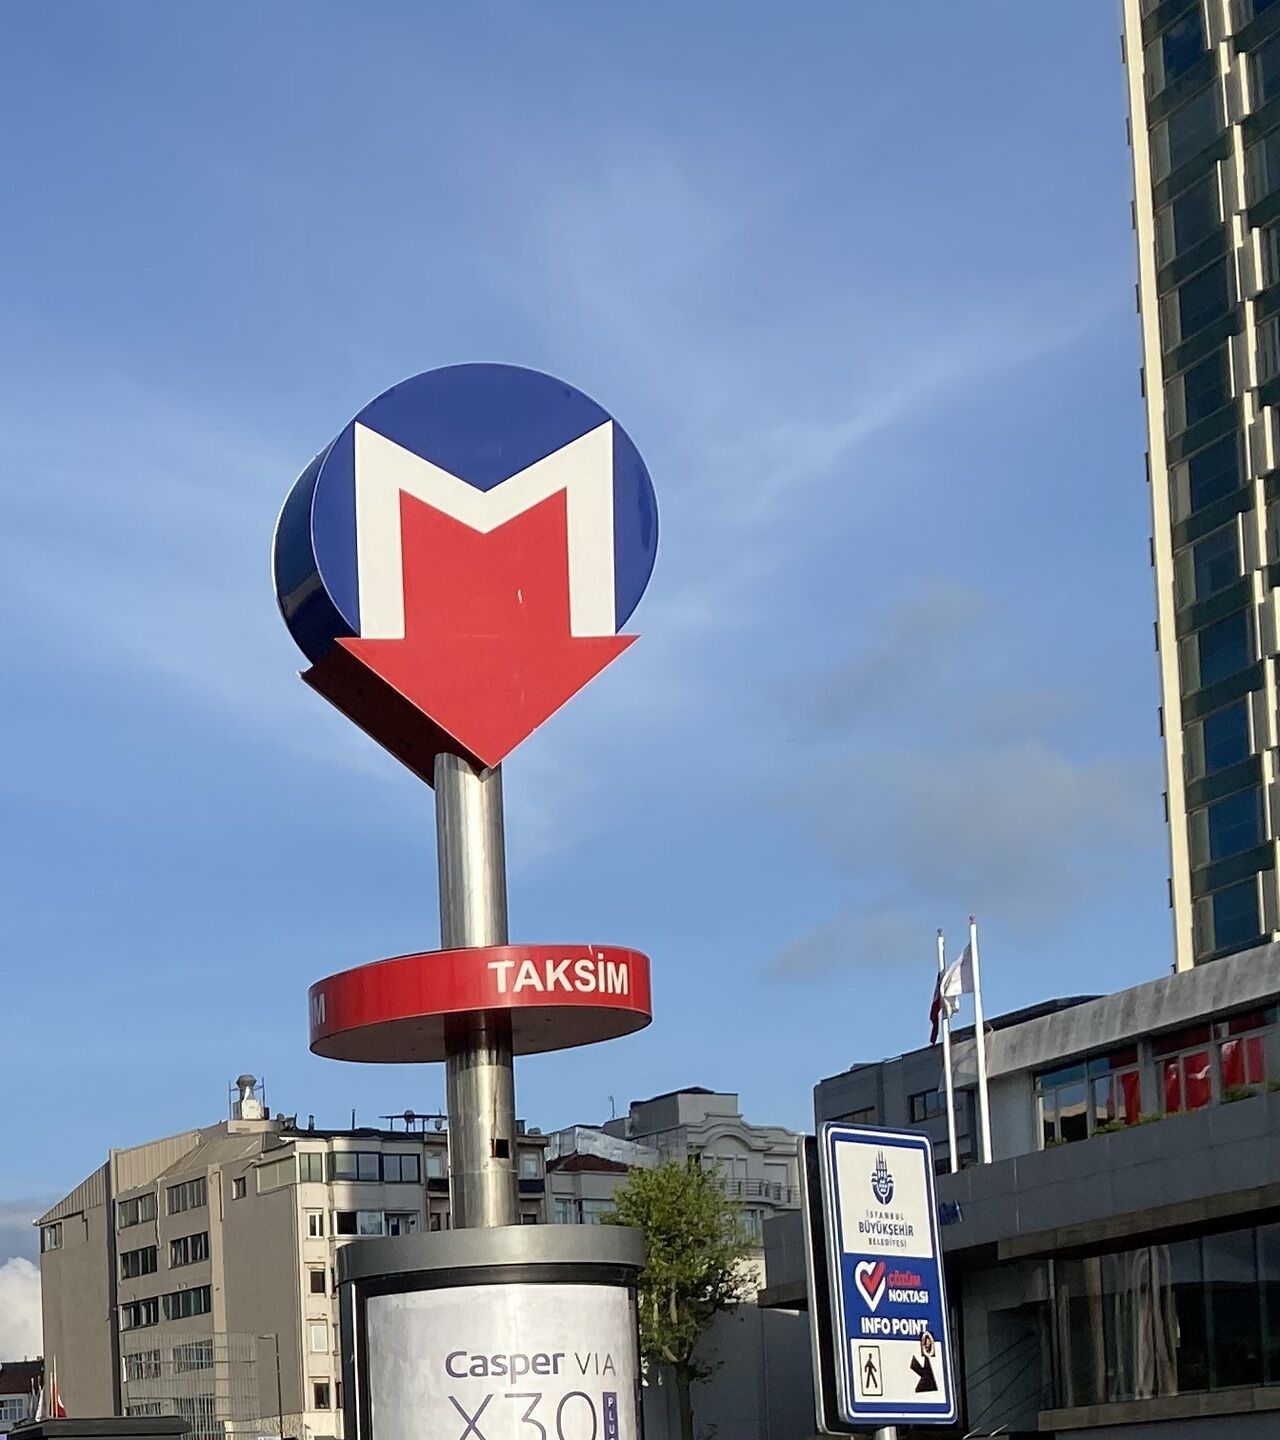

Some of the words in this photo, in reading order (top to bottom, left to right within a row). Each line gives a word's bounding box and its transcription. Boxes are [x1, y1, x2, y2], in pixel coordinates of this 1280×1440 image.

[354, 420, 616, 638] M
[488, 953, 629, 996] TAKSİM
[859, 1220, 914, 1236] BÜYÜKŞEHİR
[888, 1289, 929, 1303] NOKTASI
[861, 1317, 891, 1334] INFO
[892, 1318, 928, 1335] POINT
[446, 1351, 565, 1384] Casper
[575, 1352, 616, 1376] VIA
